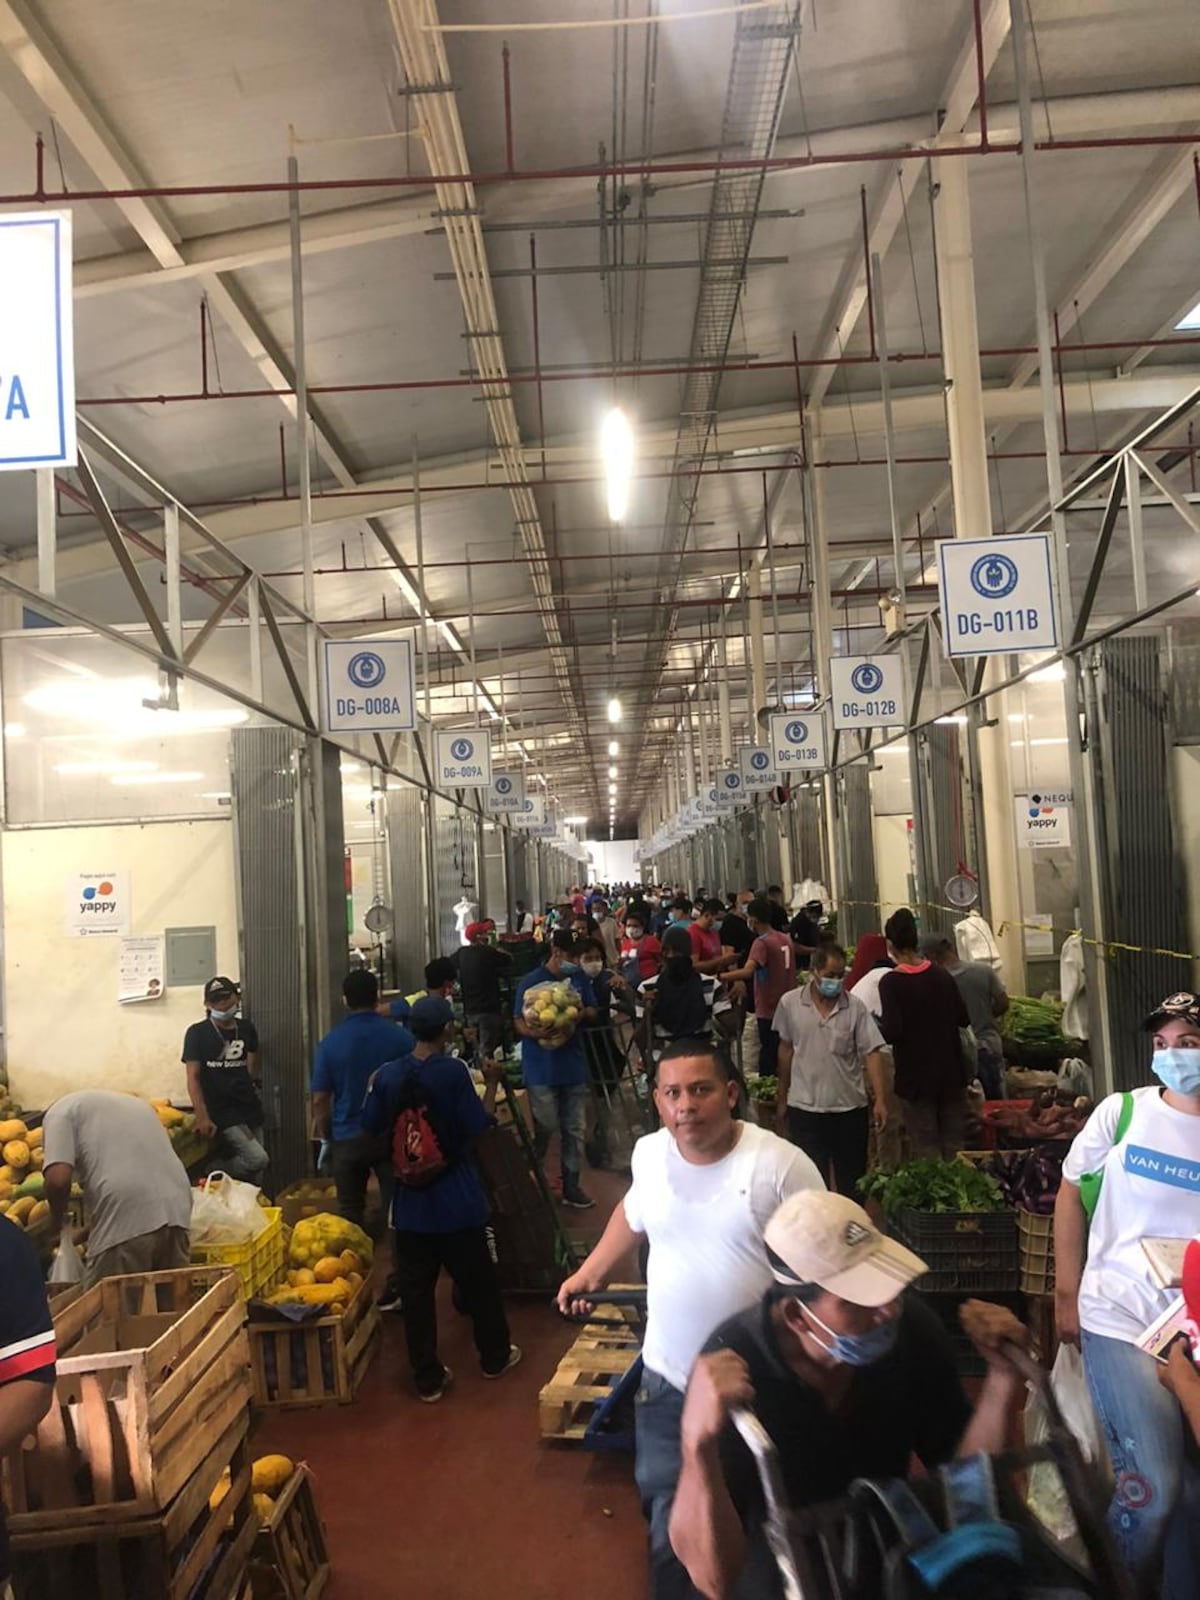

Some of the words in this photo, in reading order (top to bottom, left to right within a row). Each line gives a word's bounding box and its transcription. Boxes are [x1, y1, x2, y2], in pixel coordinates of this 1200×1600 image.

[957, 609, 1038, 635] DG-011B
[337, 697, 400, 716] DG-008A
[842, 700, 896, 718] DG-012B
[778, 748, 818, 761] DG-013B
[443, 766, 483, 778] DG-009A
[1027, 819, 1057, 829] yappy
[80, 902, 116, 913] yappy
[1129, 1153, 1160, 1171] VAN
[1164, 1164, 1200, 1181] HEU
